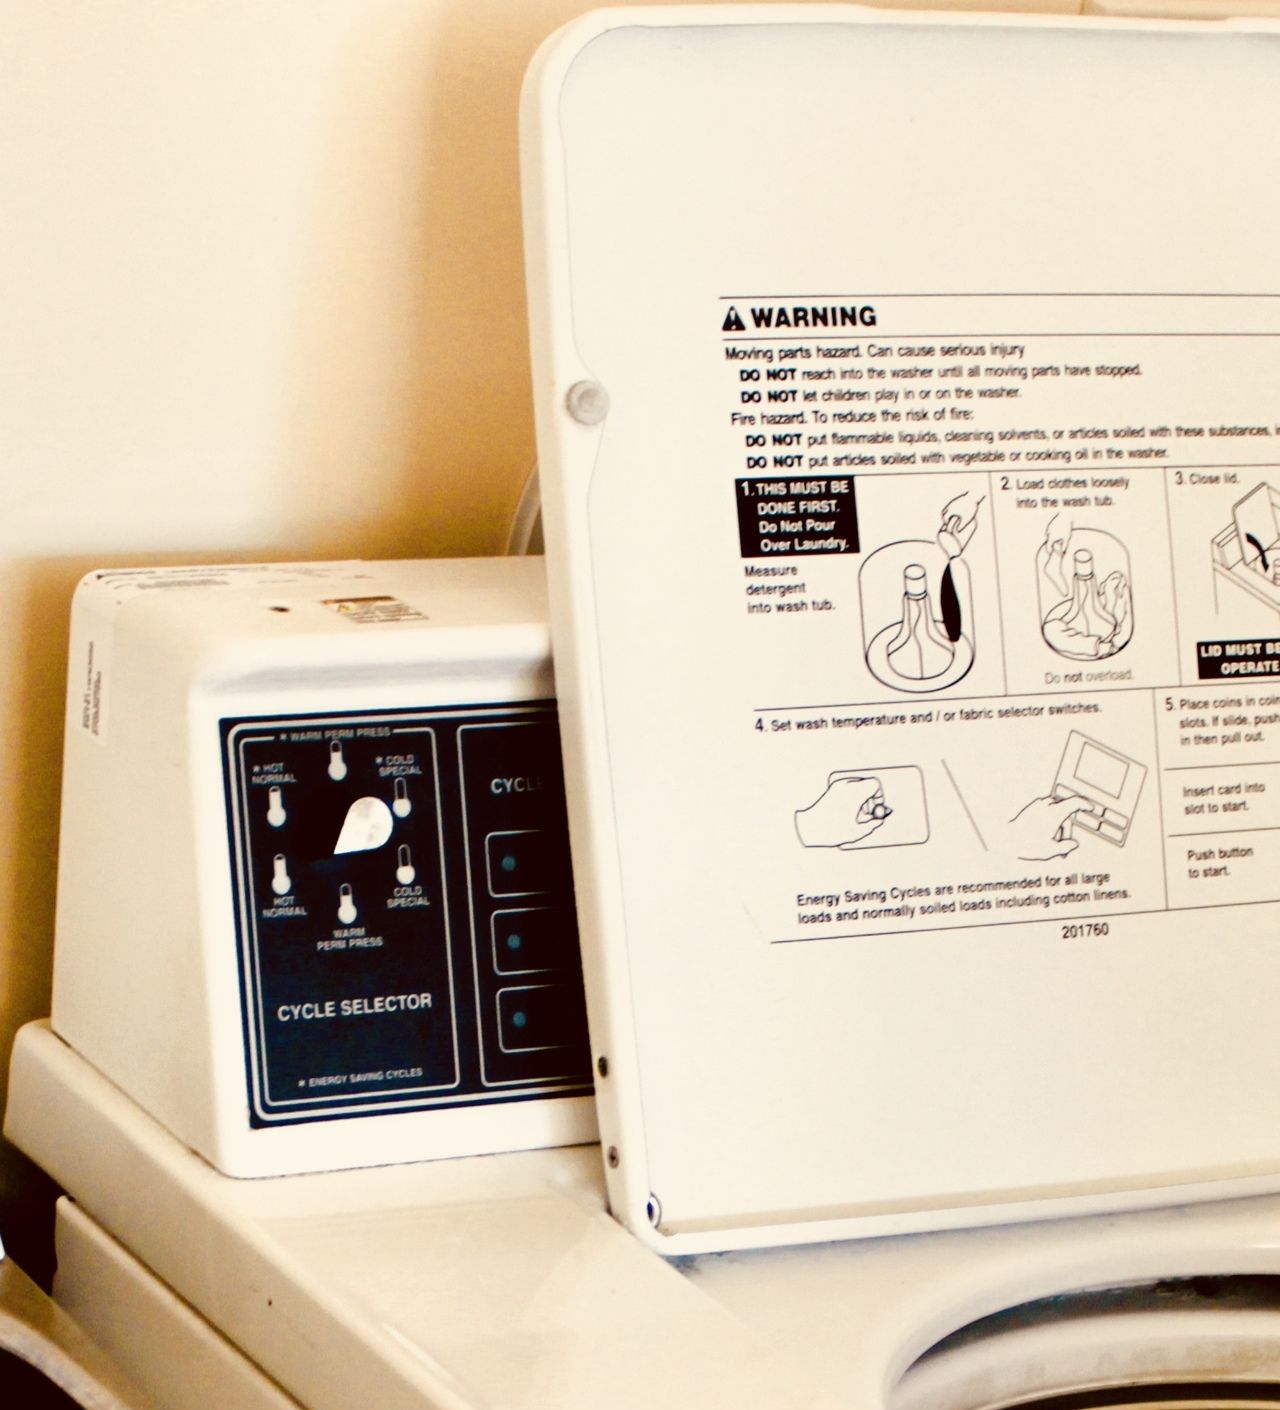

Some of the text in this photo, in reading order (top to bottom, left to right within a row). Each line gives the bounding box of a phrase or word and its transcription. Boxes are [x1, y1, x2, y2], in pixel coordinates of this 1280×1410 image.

[749, 305, 876, 328] WARNING
[724, 346, 774, 363] Moving
[777, 346, 812, 362] parts
[866, 343, 893, 358] Can
[896, 345, 935, 357] cause
[939, 344, 986, 356] serious
[738, 368, 761, 382] DO
[765, 367, 797, 381] NOT
[801, 367, 835, 380] reach
[840, 368, 863, 379] into
[866, 367, 885, 379] the
[890, 367, 933, 378] washer
[939, 366, 962, 378] until
[967, 365, 980, 377] all
[984, 366, 1028, 380] moving
[1031, 365, 1060, 378] parts
[1064, 365, 1090, 376] have
[740, 389, 762, 404] DO
[766, 388, 798, 403] NOT
[802, 390, 817, 402] let
[821, 389, 869, 402] children
[874, 389, 899, 403] play
[904, 390, 913, 399] in
[918, 389, 931, 399] or
[935, 389, 949, 399] on
[954, 387, 973, 398] the
[730, 411, 756, 426] Fire
[810, 409, 828, 424] To
[831, 409, 877, 423] reduce
[880, 409, 901, 422] the
[905, 409, 928, 421] risk
[932, 406, 946, 421] of
[745, 455, 768, 469] DO
[772, 453, 804, 468] NOT
[808, 454, 828, 469] put
[832, 453, 876, 466] articles
[880, 452, 916, 465] soiled
[920, 451, 945, 463] with
[950, 451, 1005, 466] vegetable
[1009, 451, 1021, 461] or
[1024, 449, 1071, 463] cooking
[1074, 448, 1088, 460] oil
[1092, 449, 1102, 458] in
[1105, 447, 1123, 459] the
[1015, 478, 1044, 490] Load
[1047, 477, 1088, 489] clothes
[1090, 476, 1130, 490] loosely
[1188, 472, 1221, 485] Close
[754, 481, 787, 496] THIS
[789, 480, 827, 494] MUST
[829, 479, 849, 493] BE
[756, 500, 796, 515] DONE
[1016, 497, 1038, 508] into
[1040, 496, 1058, 508] the
[1061, 495, 1091, 507] wash
[758, 518, 836, 534] Do Not Pour
[759, 538, 791, 552] Over
[743, 564, 798, 577] Measure
[745, 582, 805, 598] detergent
[747, 602, 772, 613] into
[775, 599, 808, 612] wash
[1199, 644, 1222, 658] LID
[1224, 642, 1262, 656] MUST
[1221, 660, 1280, 675] OPERATE
[1044, 671, 1061, 684] Do
[1062, 671, 1083, 683] not
[1178, 697, 1210, 710] Place
[1211, 697, 1243, 709] coins
[1245, 697, 1256, 706] in
[770, 719, 791, 732] Set
[795, 717, 828, 730] wash
[830, 713, 906, 729] temperature
[909, 710, 933, 724] and
[942, 711, 956, 722] or
[958, 708, 993, 720] fabric
[996, 705, 1044, 718] selector
[1211, 714, 1219, 726] If
[1253, 712, 1280, 727] push
[289, 726, 392, 741] WARM PERM PRESS
[262, 762, 284, 774] HOT
[385, 755, 415, 766] COLD
[251, 772, 296, 784] NORMAL
[378, 765, 422, 777] SPECIAL
[1182, 782, 1266, 797] Insert card into
[1186, 846, 1253, 861] Push button
[393, 886, 423, 897] COLD
[796, 872, 1110, 907] Energy Saving Cycles are recommended for all large
[272, 895, 294, 906] HOT
[386, 896, 430, 908] SPECIAL
[798, 911, 832, 924] loads
[835, 909, 859, 923] and
[862, 905, 916, 920] normally
[918, 900, 956, 915] soiled
[958, 898, 992, 911] loads
[995, 894, 1050, 908] including
[1052, 891, 1090, 904] cotton
[261, 906, 307, 918] NORMAL
[332, 928, 366, 940] WARM
[1061, 921, 1109, 939] 201760
[316, 936, 383, 951] PERM PRESS
[276, 992, 432, 1021] CYCLE SELECTOR
[308, 1066, 423, 1087] ENERGY SAVING CYCLES
